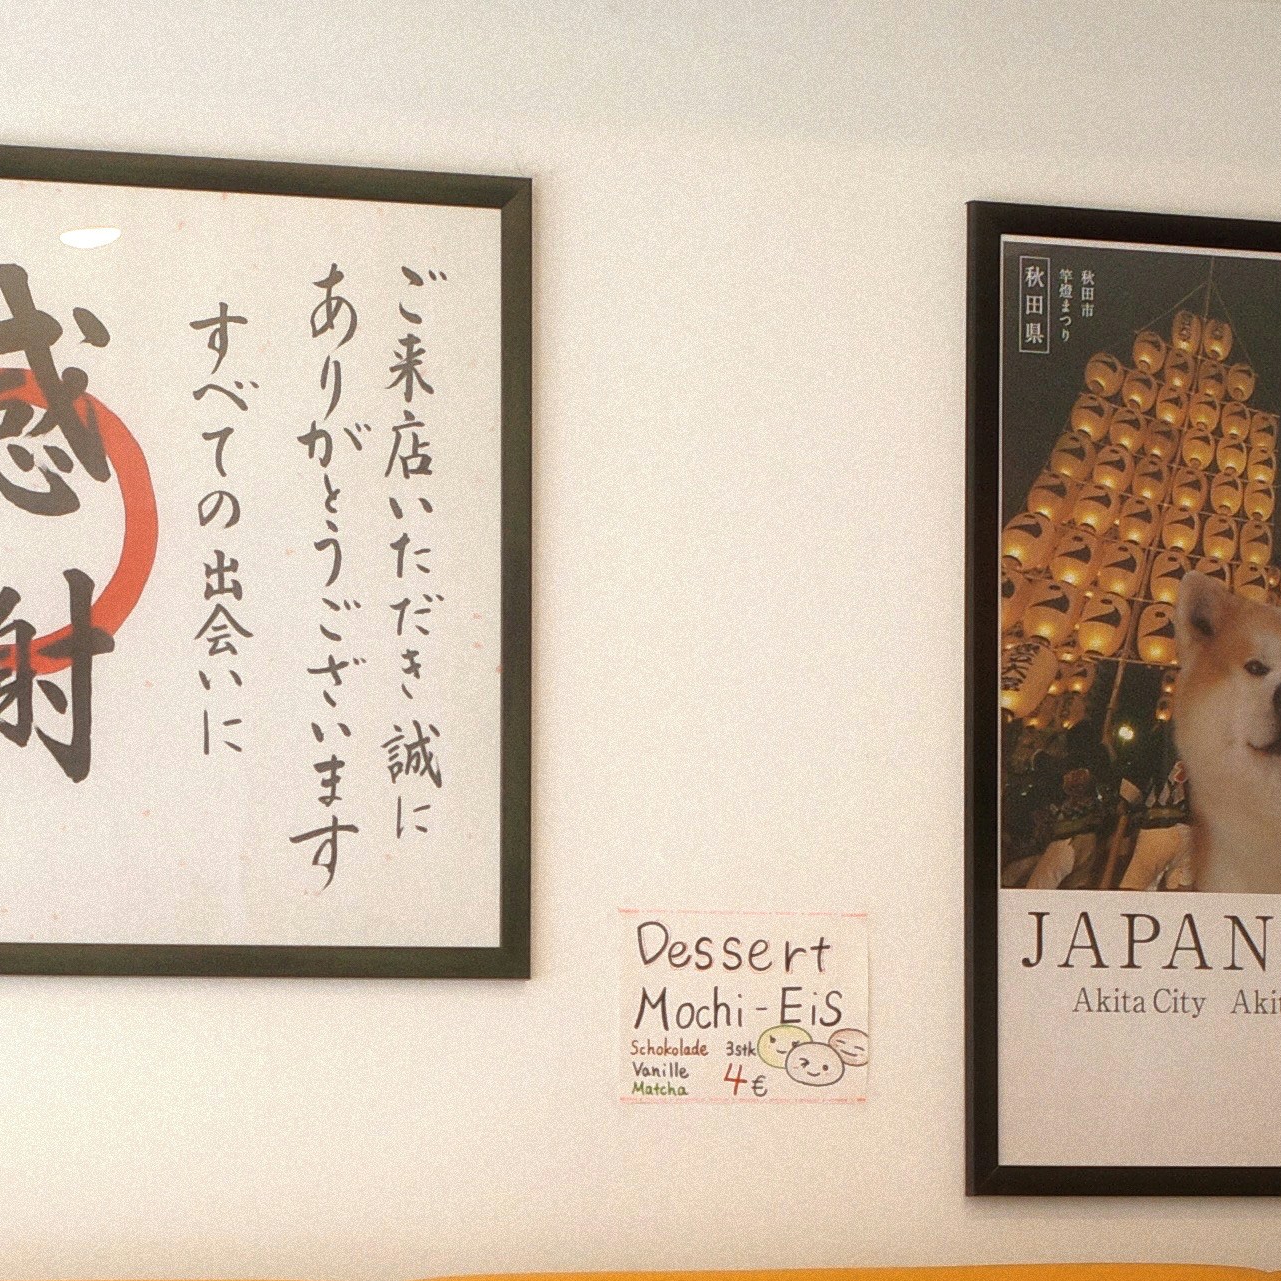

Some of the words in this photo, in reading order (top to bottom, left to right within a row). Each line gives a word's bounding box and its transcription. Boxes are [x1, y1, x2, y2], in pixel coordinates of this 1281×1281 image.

[1025, 266, 1045, 343] 秋田県
[1081, 270, 1095, 317] 秋田市
[189, 301, 259, 756] すべての出会いに
[289, 262, 372, 889] ありがとうございます
[637, 921, 831, 973] Dessert
[1021, 911, 1274, 972] JAPAN
[1072, 986, 1146, 1014] Akita
[1152, 987, 1207, 1019] City
[630, 1037, 709, 1057] Schokolade
[632, 1061, 690, 1079] Vanille
[631, 1081, 689, 1096] Matcha
